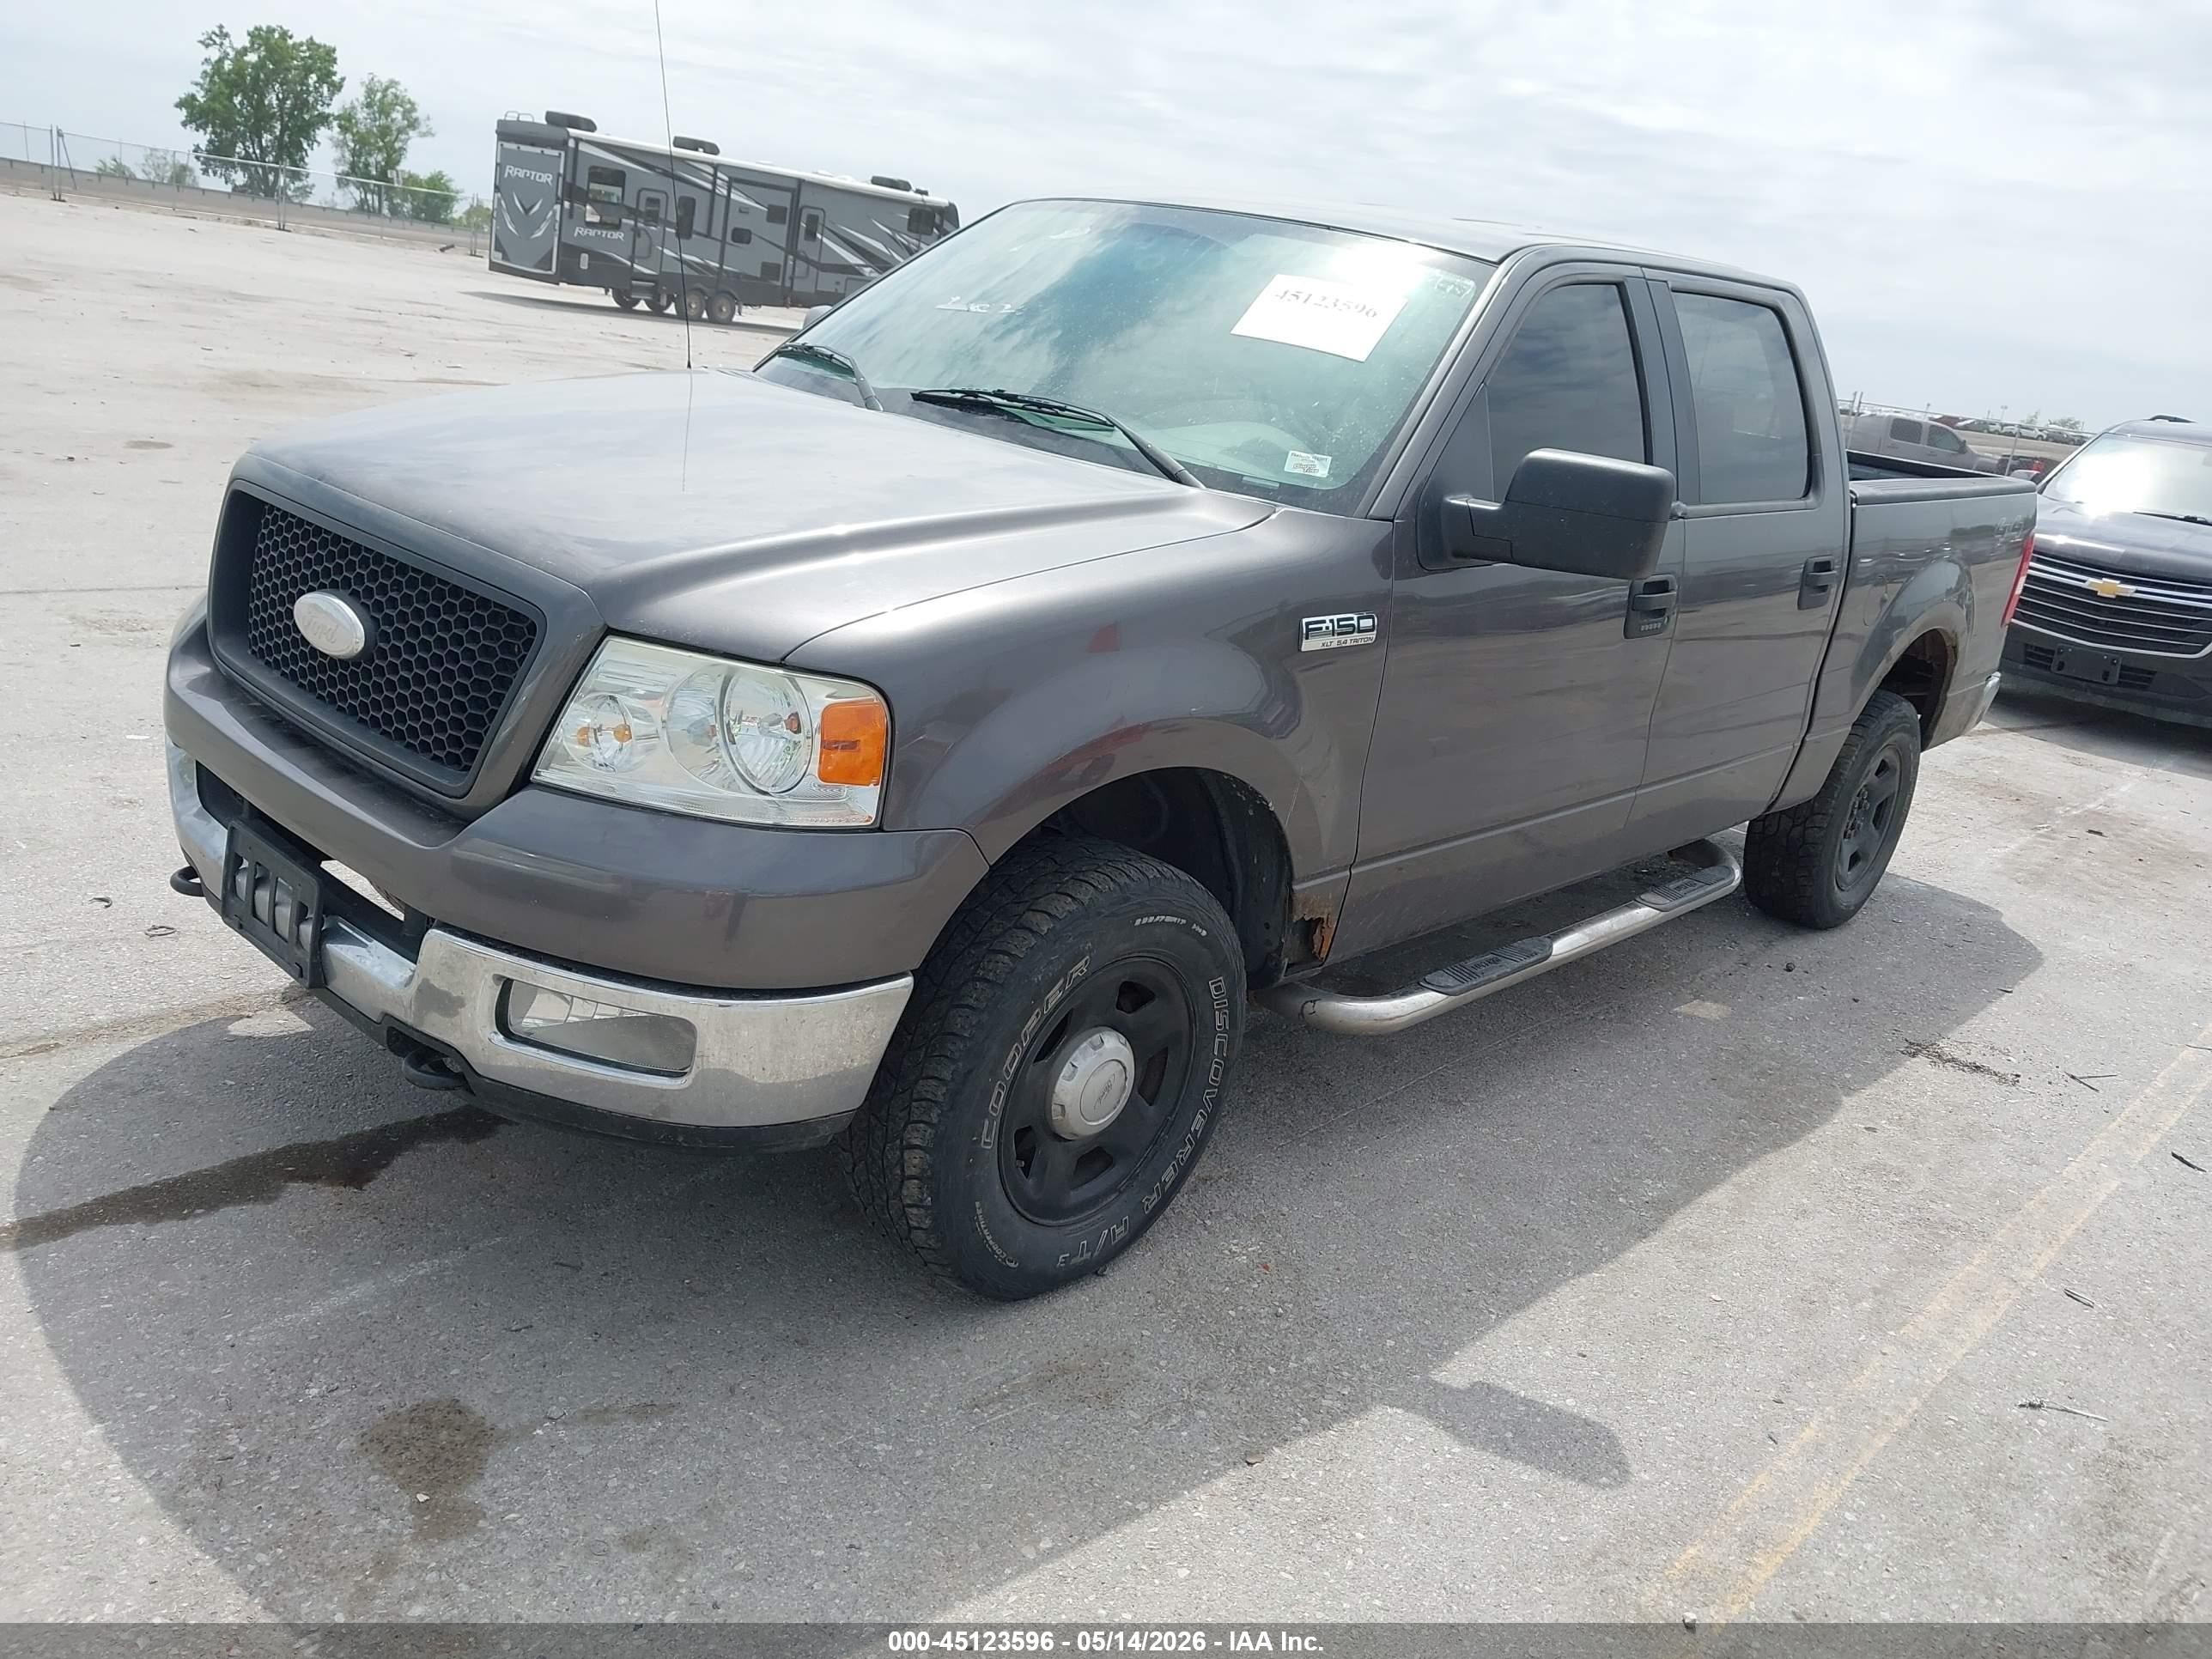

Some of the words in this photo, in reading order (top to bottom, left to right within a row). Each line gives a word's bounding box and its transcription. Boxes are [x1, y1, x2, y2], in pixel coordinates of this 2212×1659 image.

[504, 165, 553, 186] RAPTOR
[574, 227, 625, 241] RAPTOR
[1304, 614, 1376, 640] F-150
[1350, 635, 1374, 645] TRITON
[981, 956, 1090, 1149] COOPER
[1143, 976, 1229, 1215] DISCOVERER
